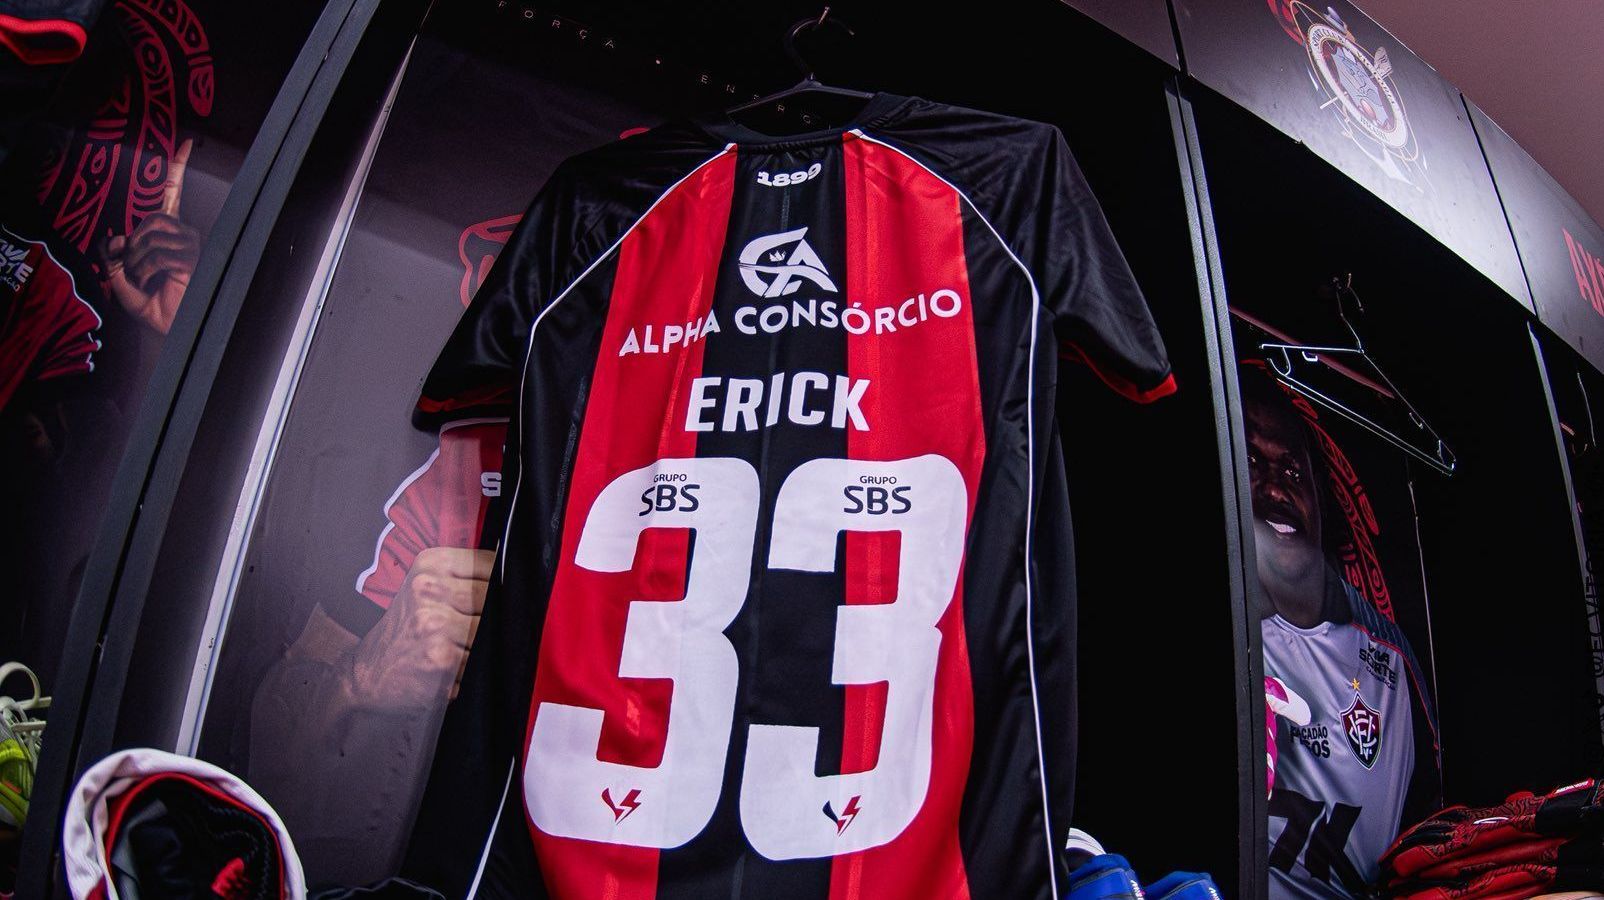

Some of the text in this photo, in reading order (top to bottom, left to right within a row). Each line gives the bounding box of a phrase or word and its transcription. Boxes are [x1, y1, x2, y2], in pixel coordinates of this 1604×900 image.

[757, 162, 823, 188] 1899
[618, 288, 962, 357] ALPHA CONSÓRCIO
[684, 371, 871, 432] ERICK
[653, 473, 688, 483] GRUPO
[859, 475, 897, 485] GRUPO
[638, 484, 700, 517] SBS
[843, 486, 912, 515] SBS
[522, 453, 968, 862] 33
